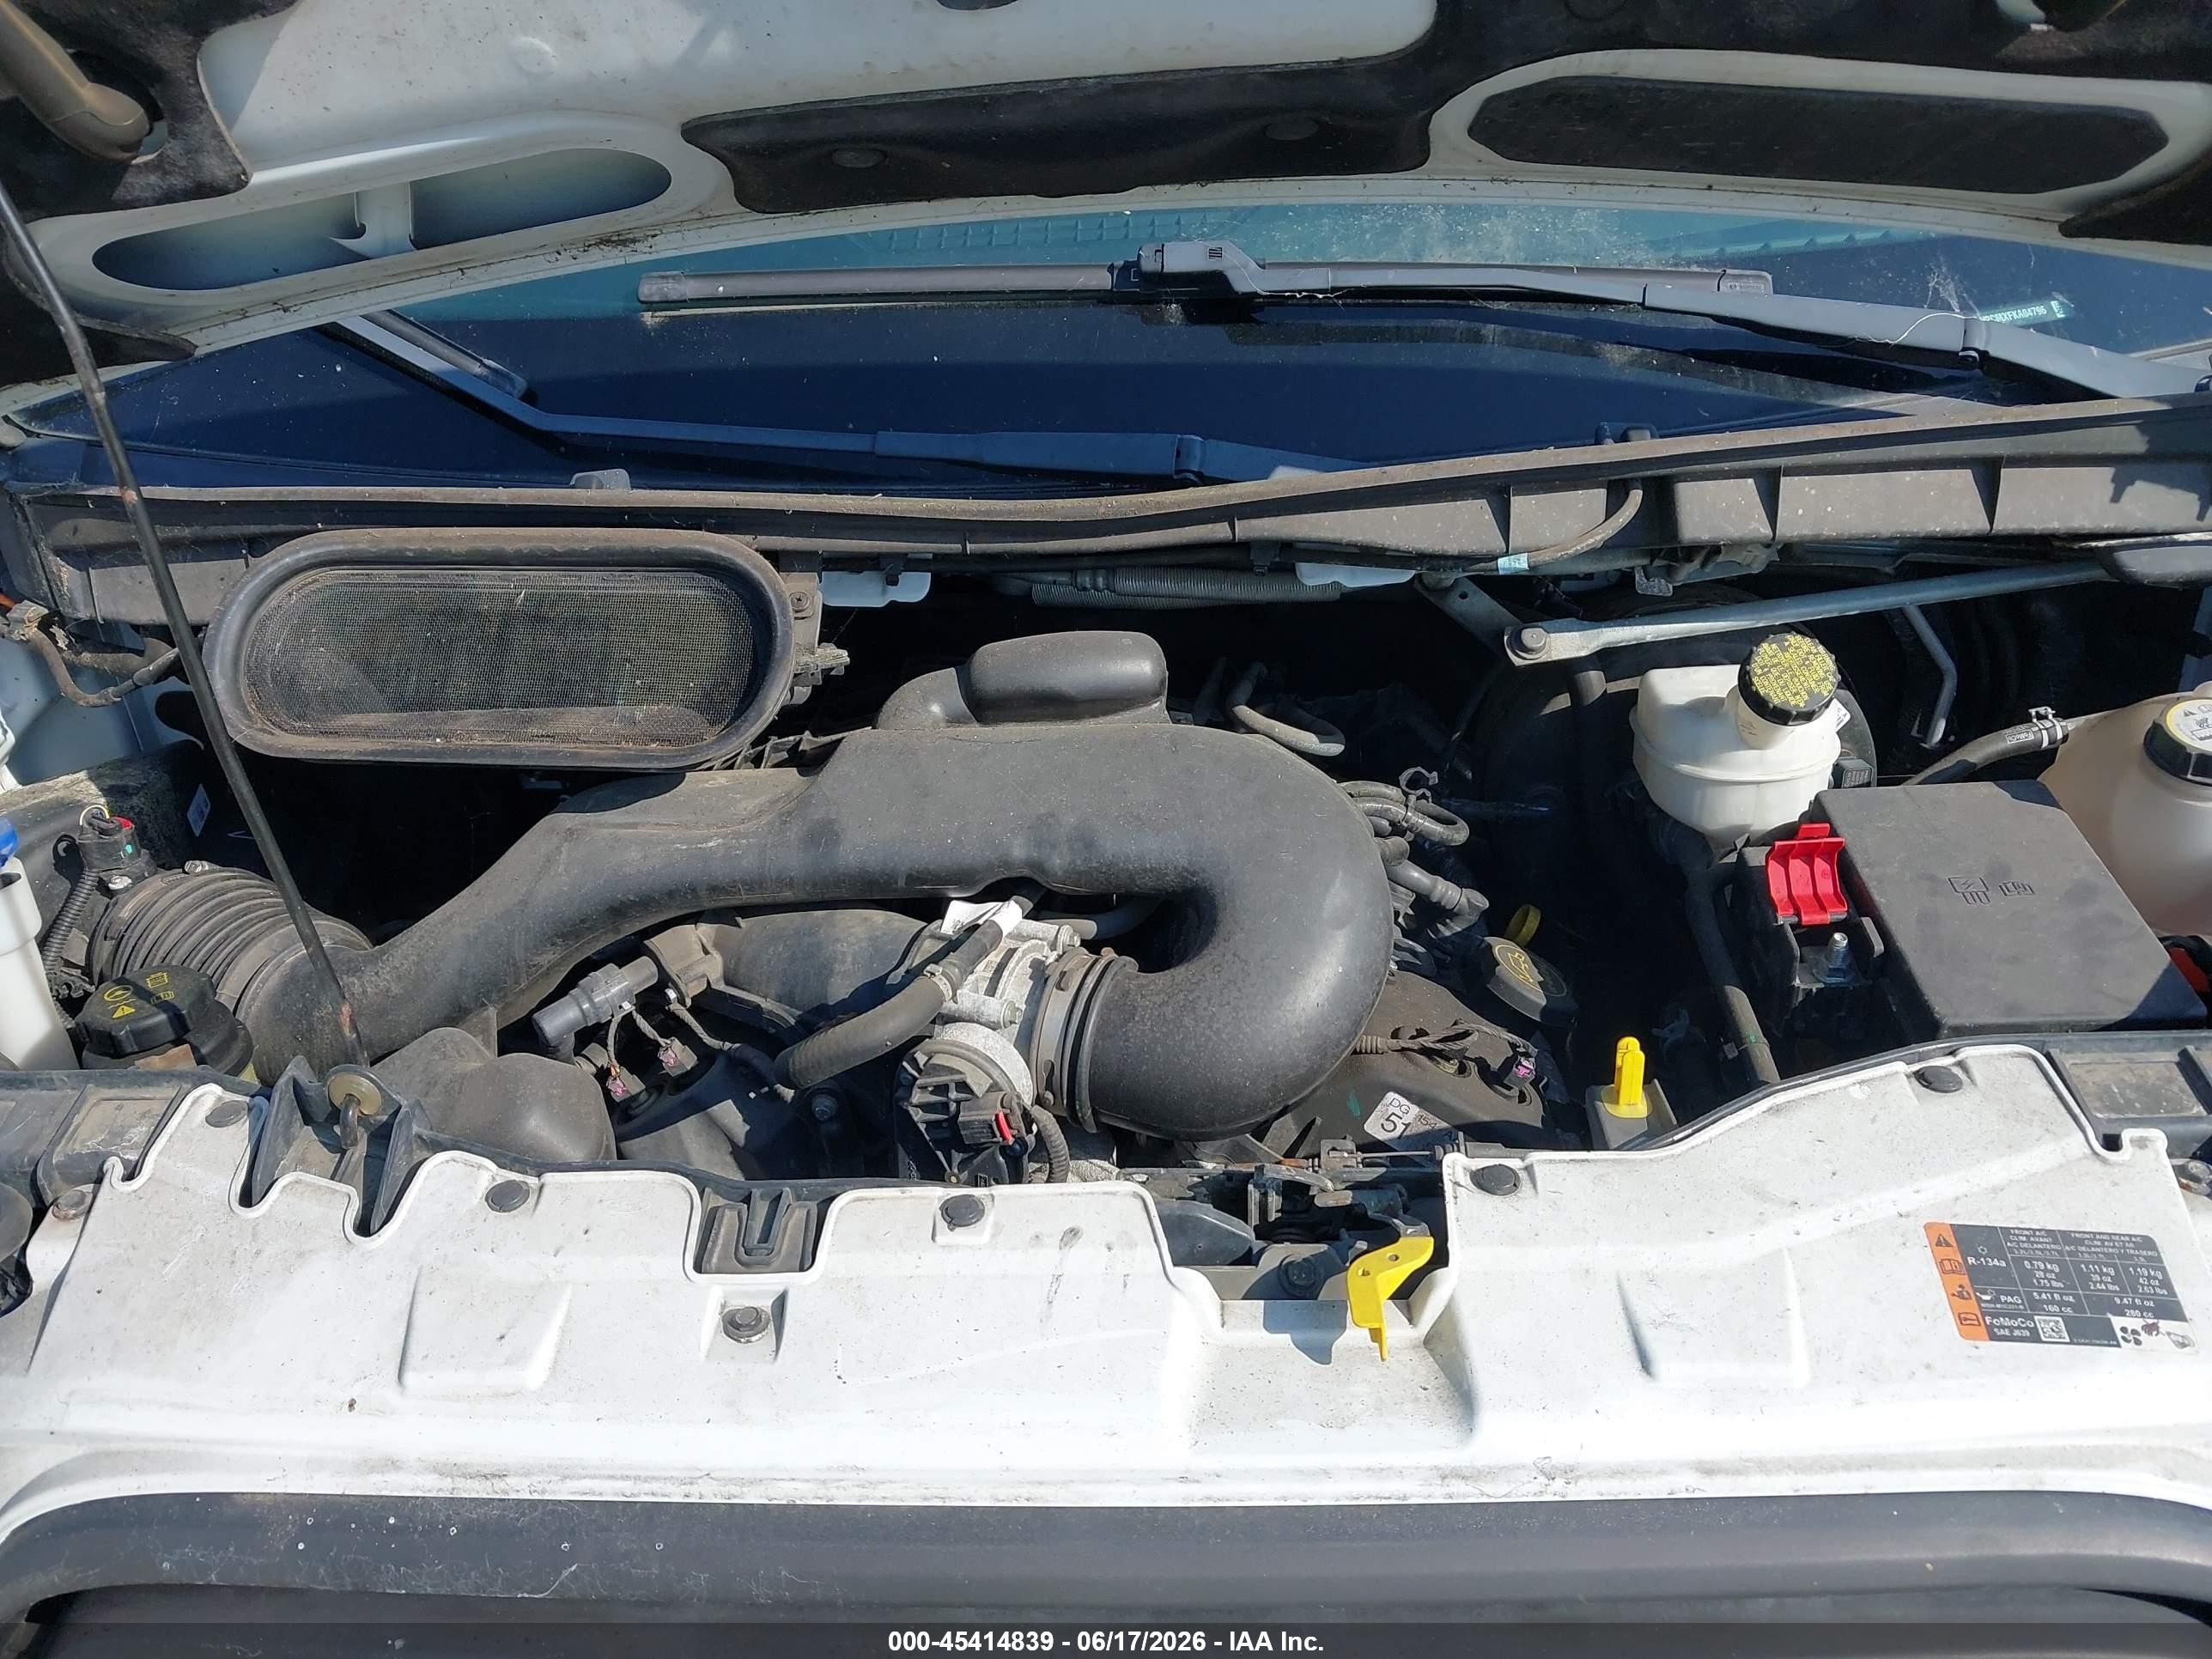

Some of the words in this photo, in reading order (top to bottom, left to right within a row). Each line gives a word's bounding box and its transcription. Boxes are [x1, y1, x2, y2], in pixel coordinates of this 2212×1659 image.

[1796, 648, 1805, 658] DOT
[1826, 672, 1835, 682] CAP
[1389, 1097, 1410, 1115] DG
[1381, 1112, 1412, 1139] 51
[1966, 1256, 2006, 1267] R-134a
[2024, 1261, 2044, 1270] 0.79
[2045, 1261, 2060, 1273] kg
[2081, 1263, 2100, 1273] 1.11
[2101, 1265, 2115, 1276] kg
[2129, 1267, 2148, 1276] 1.19
[2148, 1268, 2163, 1279] kg
[2033, 1279, 2051, 1287] 1.75
[2051, 1279, 2064, 1288] lbs
[2089, 1281, 2106, 1290] 2.44
[2106, 1282, 2120, 1291] lbs
[2137, 1285, 2155, 1294] 2.63
[2155, 1285, 2168, 1295] lbs
[2000, 1295, 2022, 1304] PAG
[2033, 1291, 2052, 1300] 5.41
[2053, 1292, 2061, 1301] fl
[2124, 1309, 2142, 1317] 280
[1984, 1316, 2034, 1328] FoMoCo
[1993, 1328, 2011, 1336] SAE
